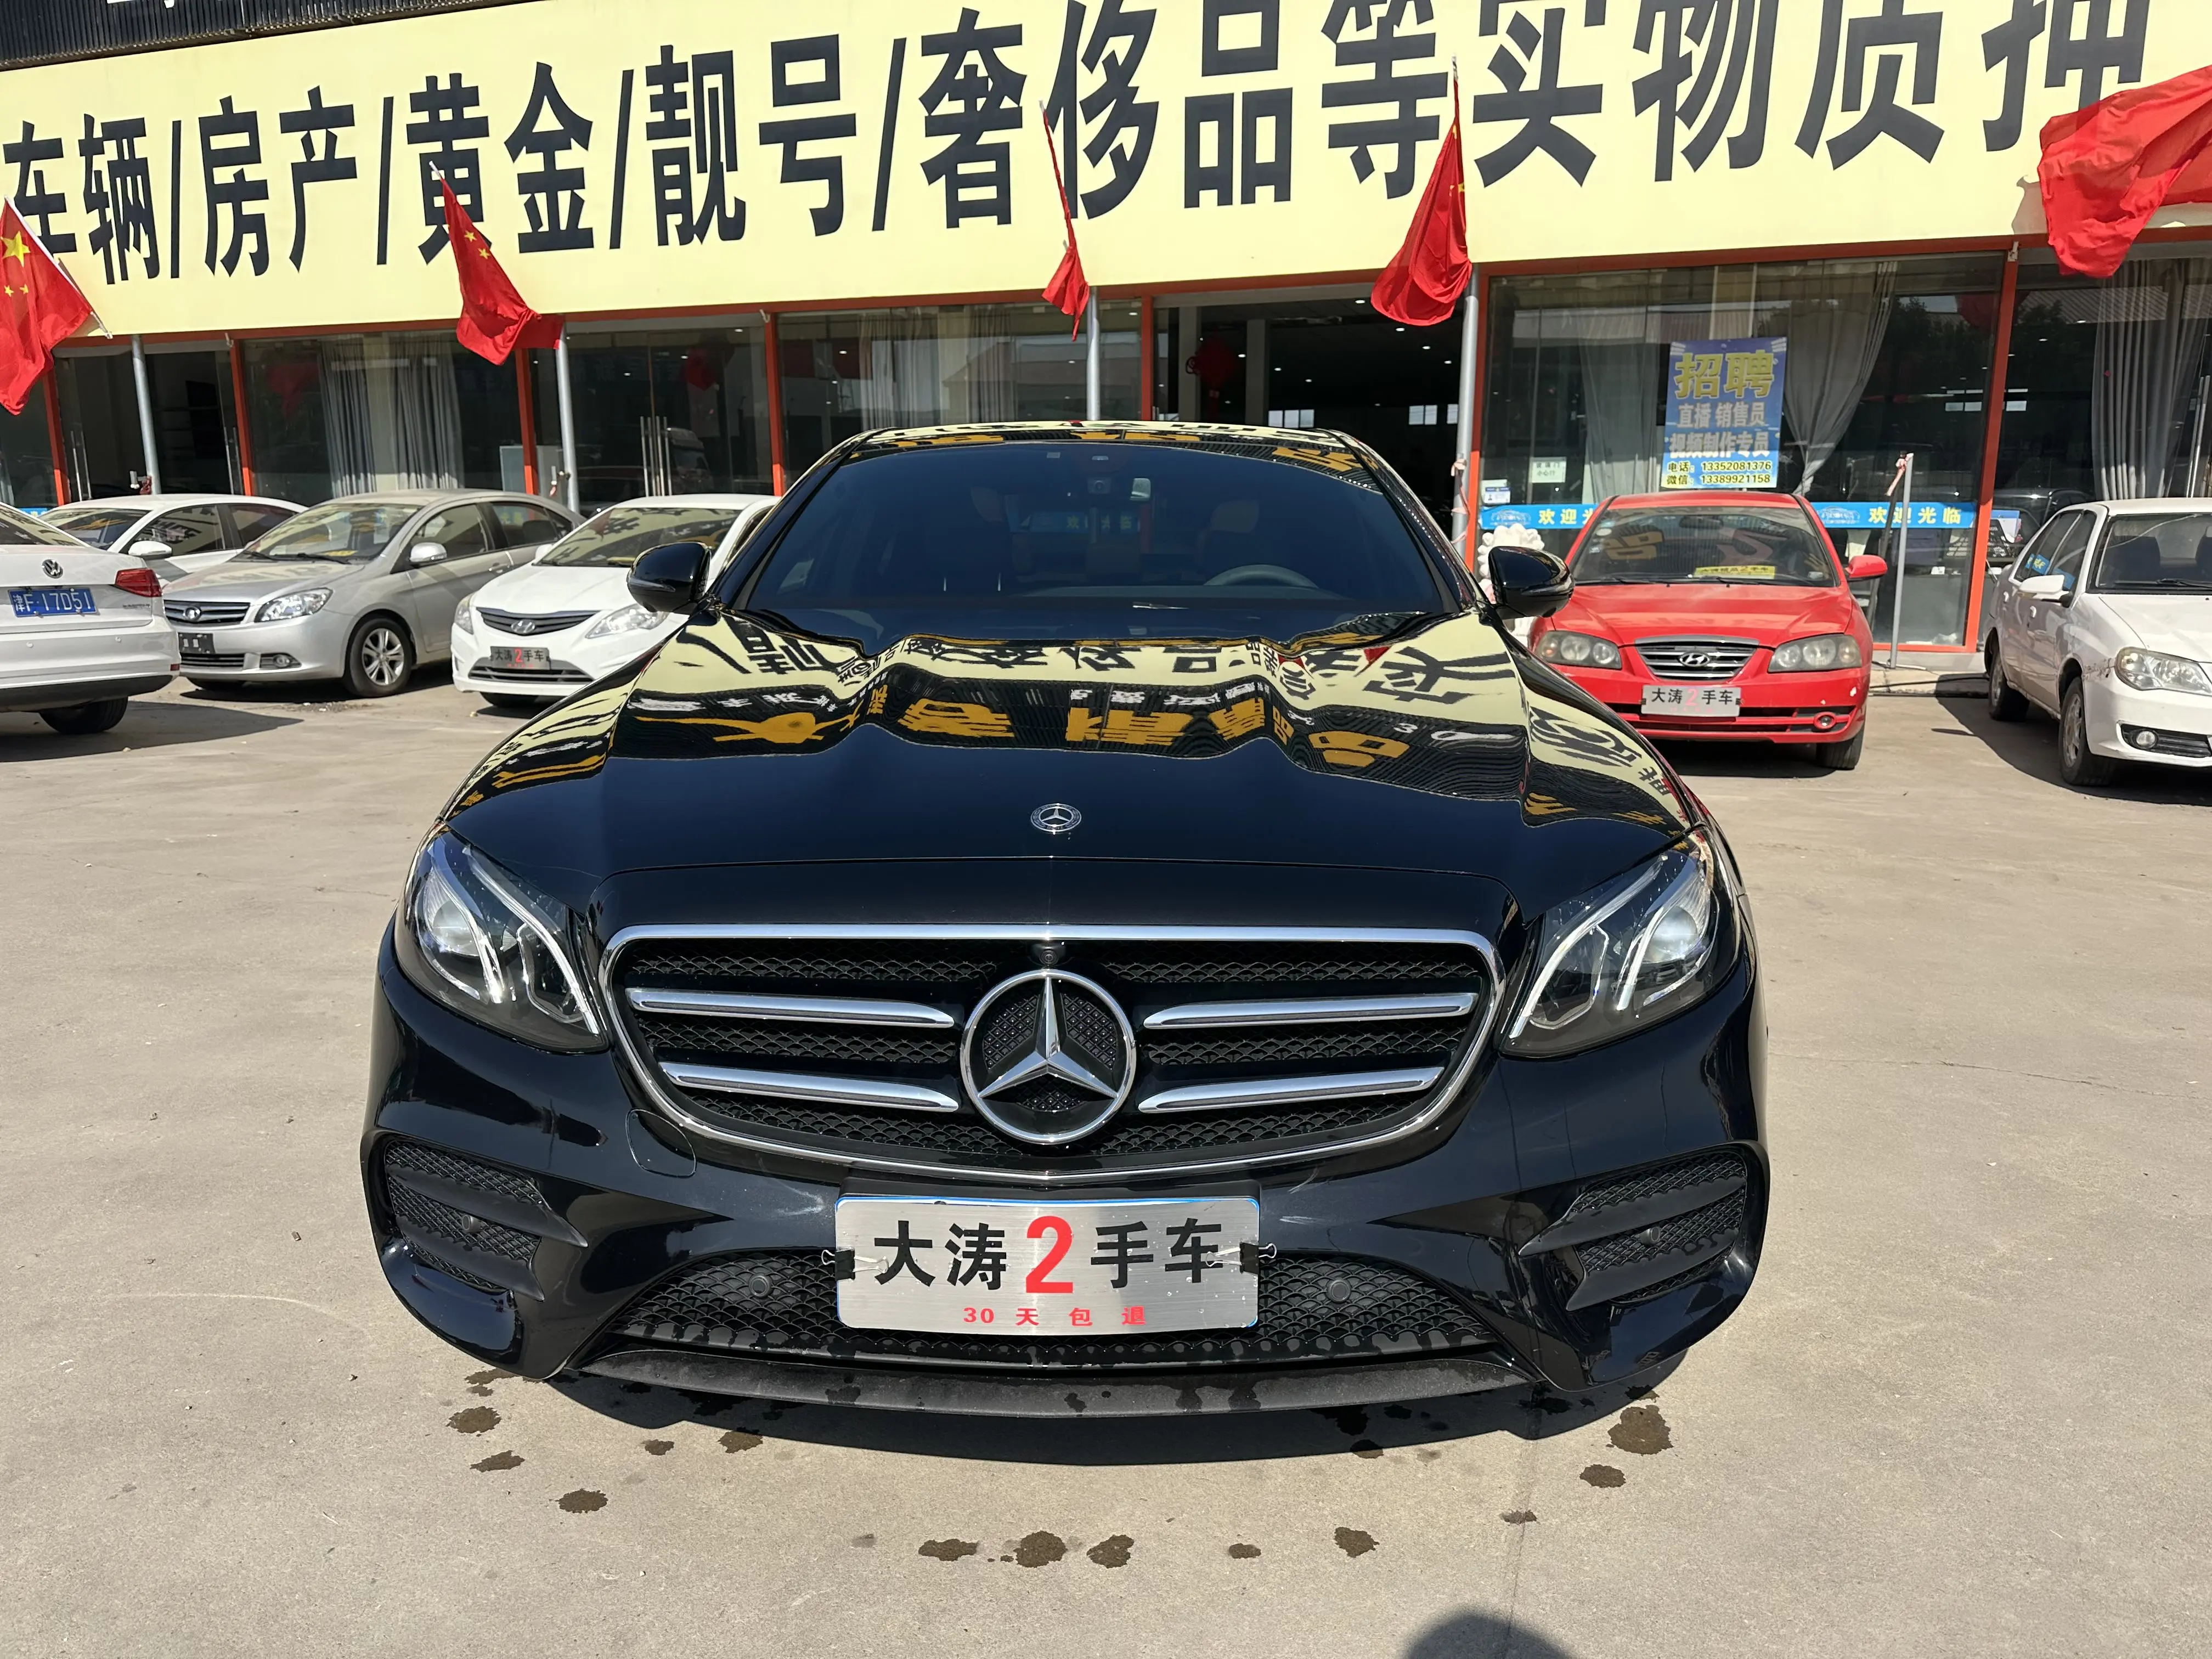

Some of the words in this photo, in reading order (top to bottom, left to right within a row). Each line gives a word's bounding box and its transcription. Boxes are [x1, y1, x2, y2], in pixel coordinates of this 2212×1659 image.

[1673, 349, 1775, 399] 招聘
[1677, 403, 1712, 428] 直播
[1716, 401, 1767, 428] 销售员
[1669, 431, 1770, 458] 视频制作专员
[1701, 461, 1772, 471] 13352081376
[1701, 475, 1770, 483] 13389921158
[1868, 507, 1962, 524] 欢迎光临
[1651, 687, 1734, 706] 大涛2手车
[873, 1215, 1223, 1294] 大涛2手车
